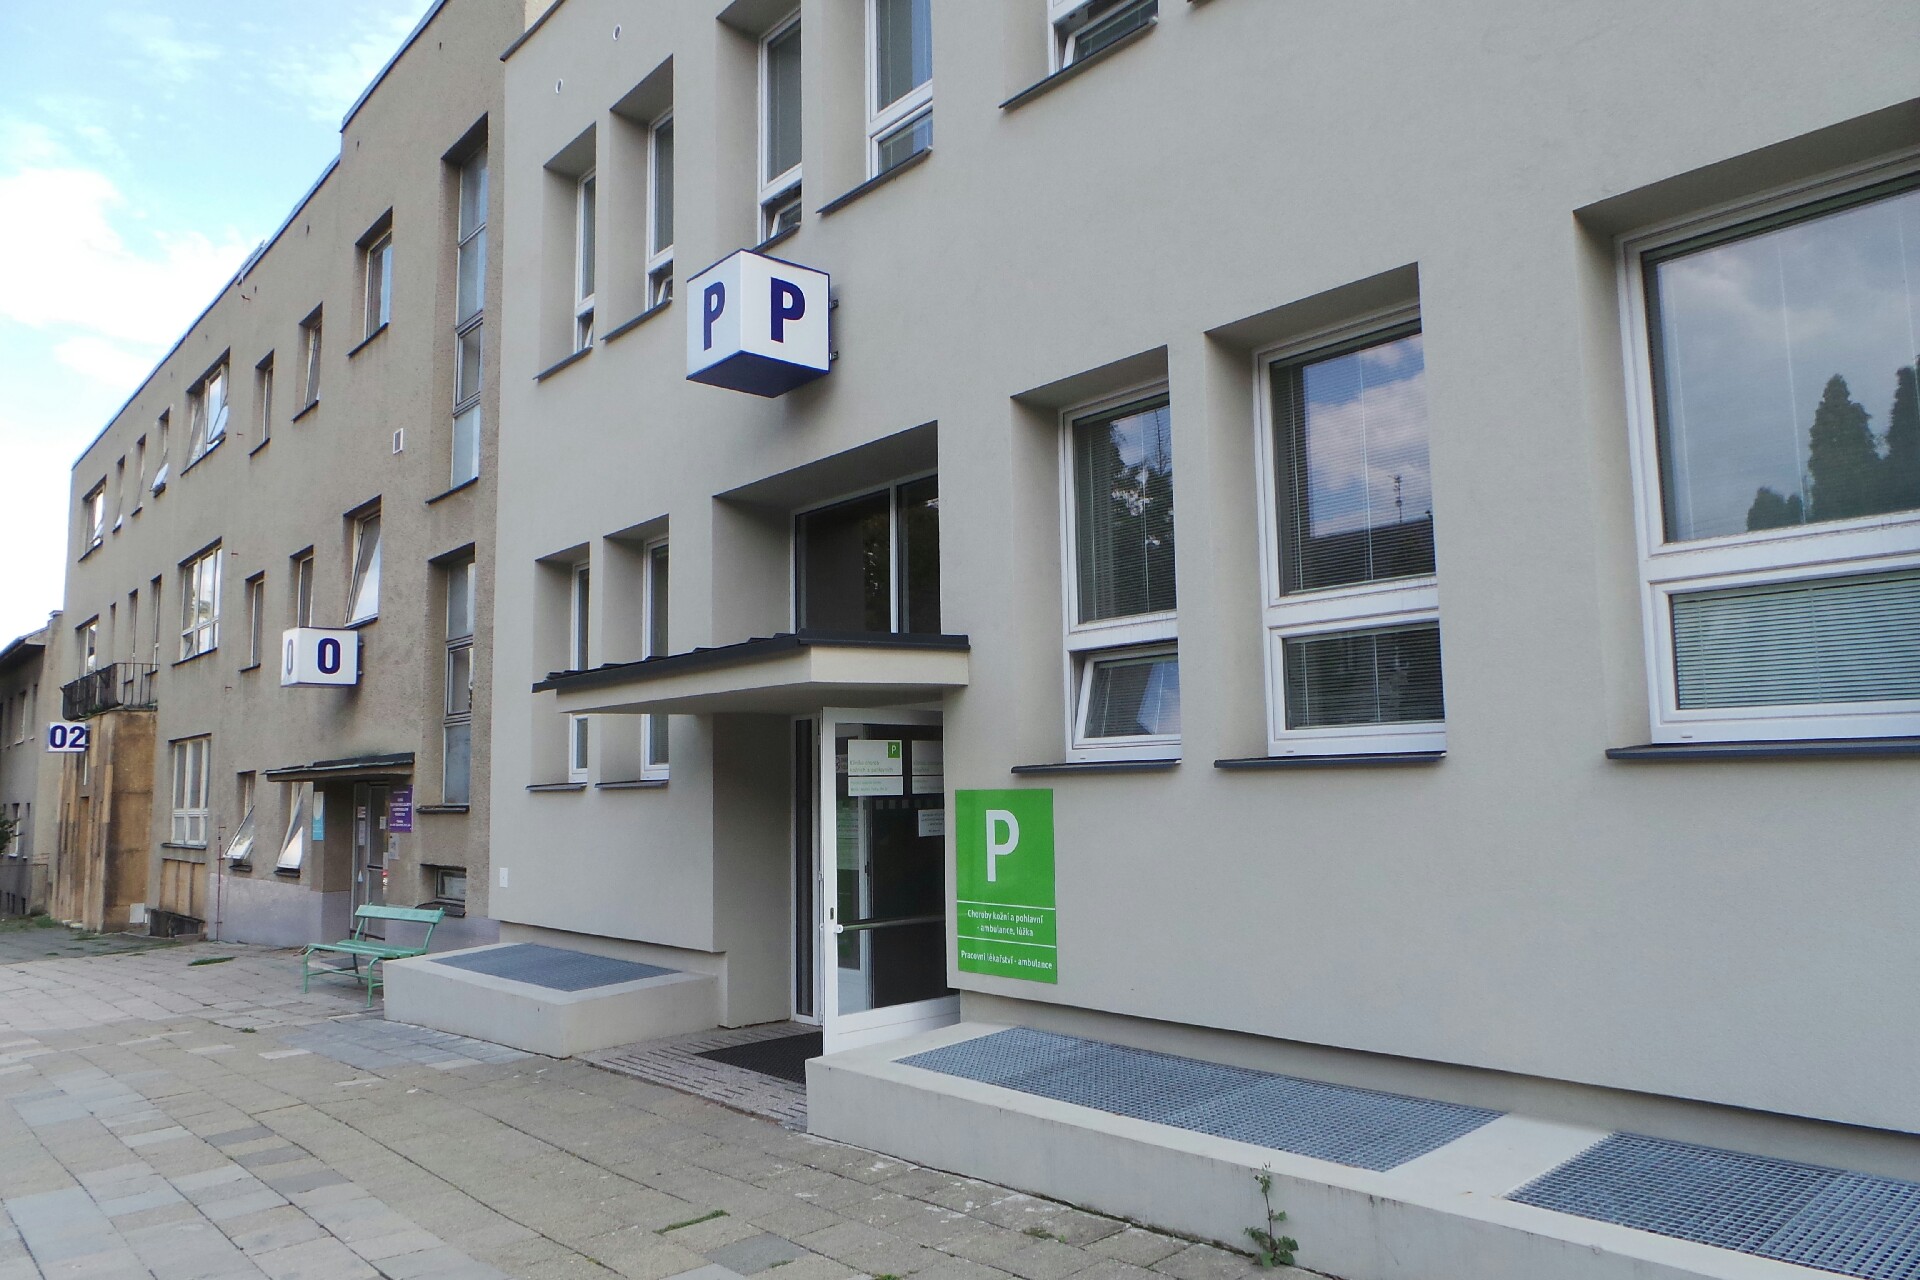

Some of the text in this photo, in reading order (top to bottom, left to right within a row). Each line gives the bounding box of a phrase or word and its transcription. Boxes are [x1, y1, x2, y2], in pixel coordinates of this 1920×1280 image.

[703, 281, 725, 351] P
[770, 276, 806, 344] P
[891, 744, 897, 755] P
[985, 809, 1020, 882] P
[967, 909, 1044, 924] Choroby kožní a pohlavní
[980, 923, 1015, 936] ambulance,
[961, 949, 986, 961] Pracovní
[986, 951, 1014, 965] lékařství
[1017, 957, 1053, 970] ambulance
